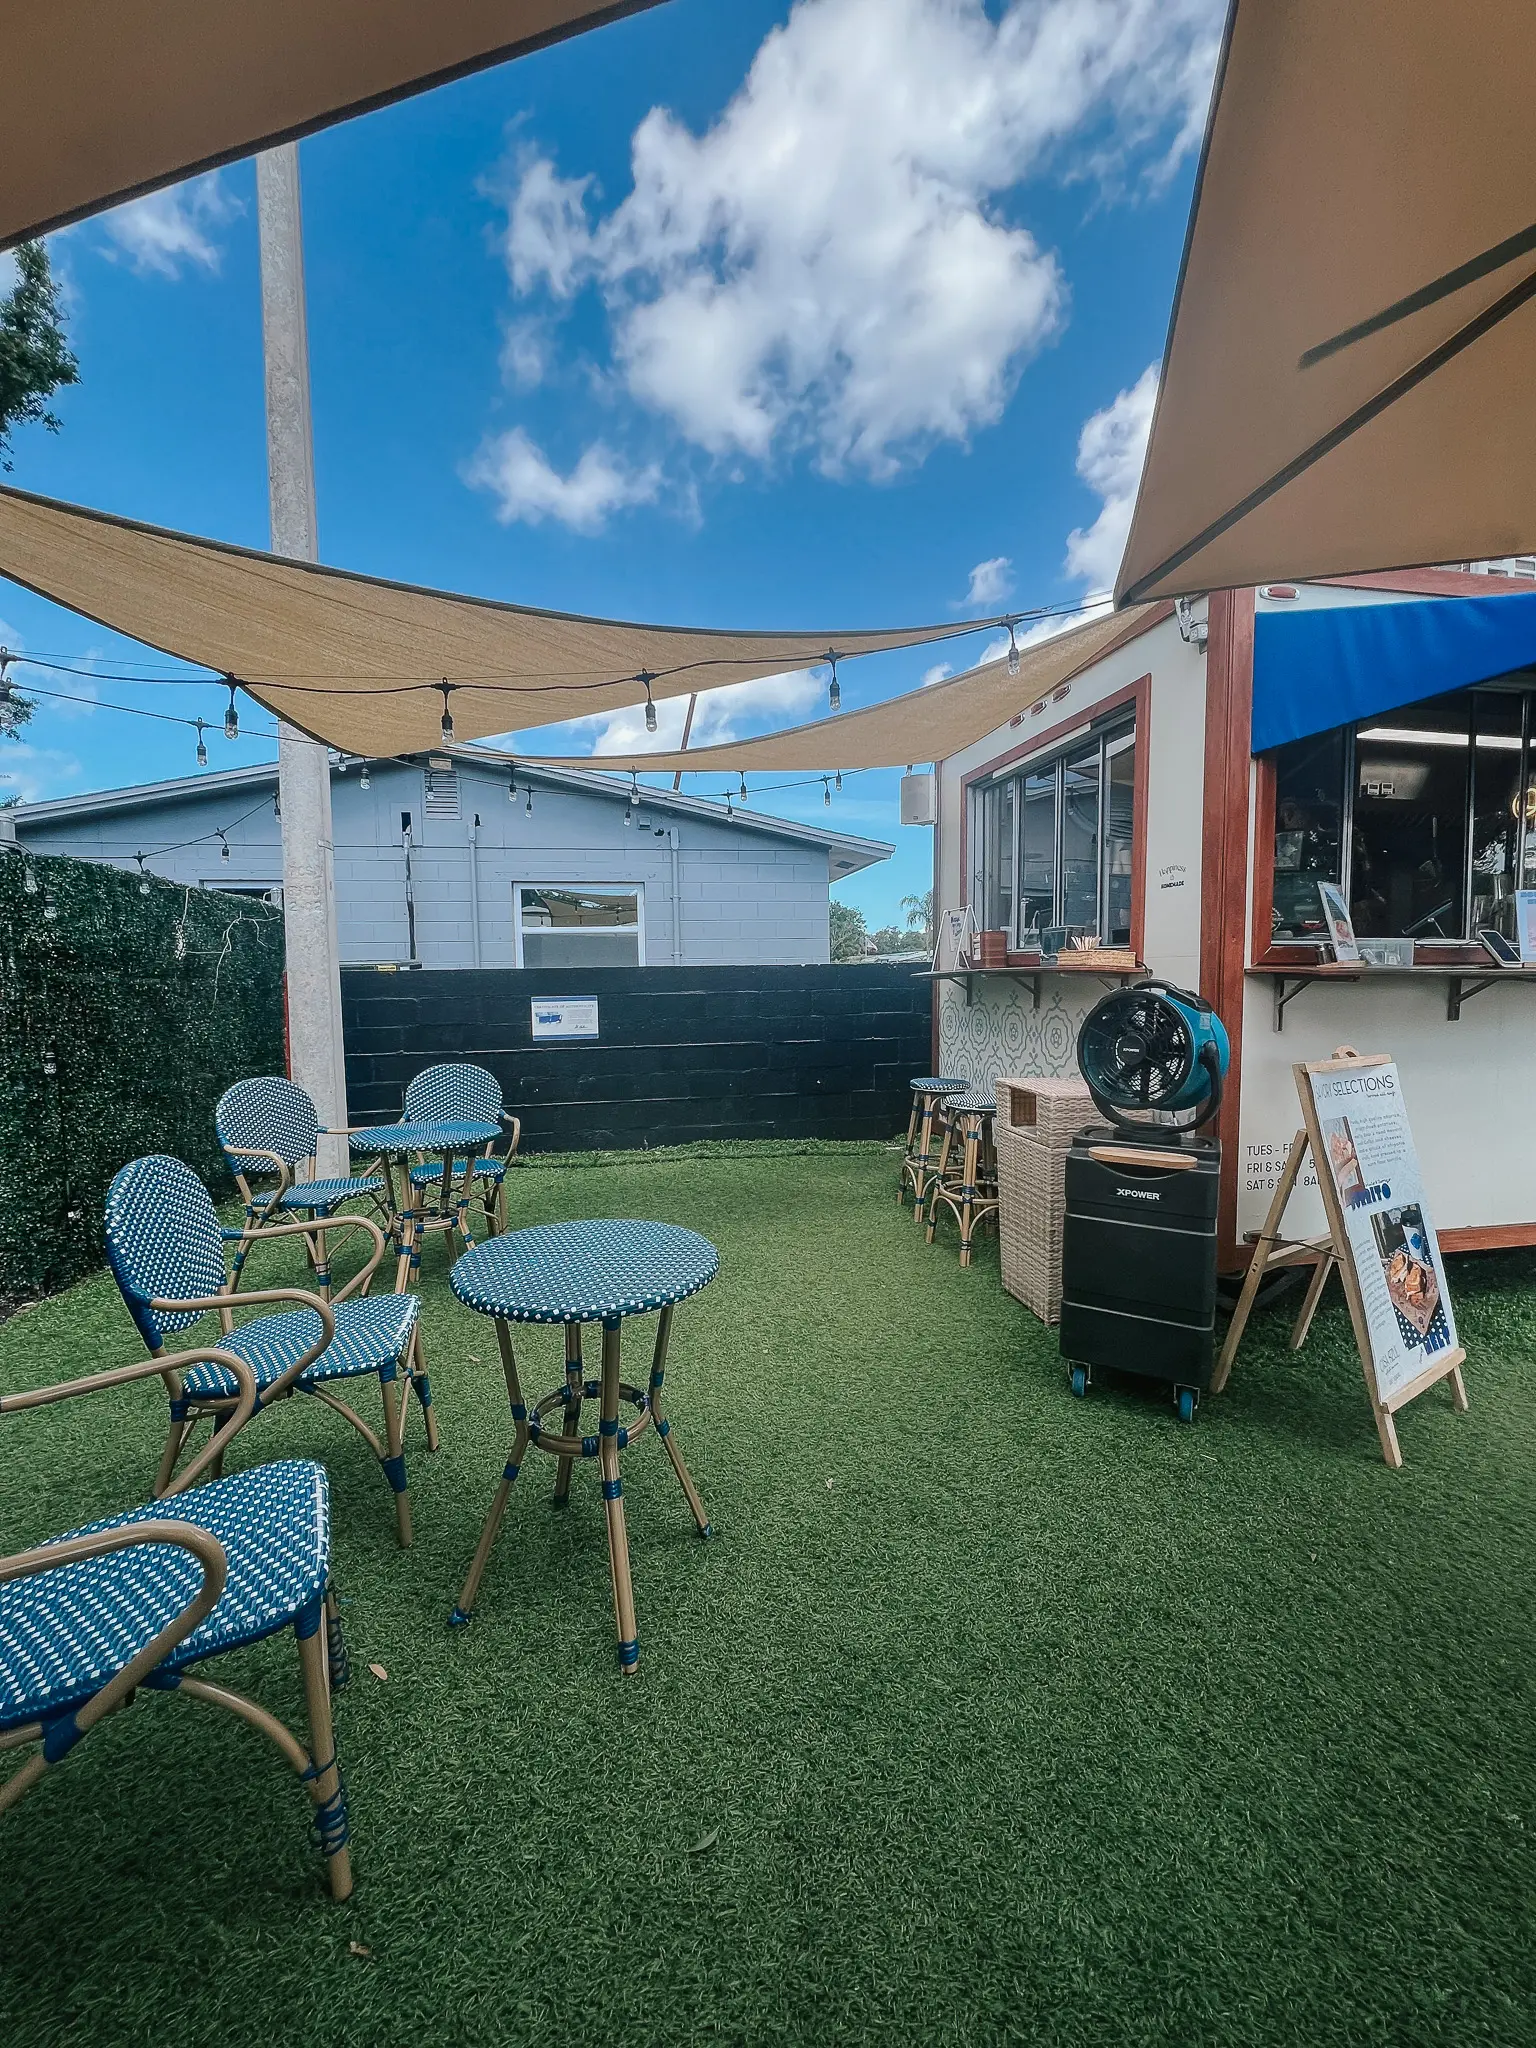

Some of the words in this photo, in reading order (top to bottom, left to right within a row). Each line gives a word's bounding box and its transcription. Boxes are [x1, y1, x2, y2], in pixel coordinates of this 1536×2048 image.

[1332, 1074, 1395, 1097] SELECTIONS
[1246, 1144, 1273, 1156] TUES
[1247, 1162, 1263, 1173] FRI
[1265, 1161, 1273, 1172] &
[1246, 1179, 1265, 1191] SAT
[1267, 1178, 1275, 1189] &
[1116, 1188, 1160, 1201] XPOWER
